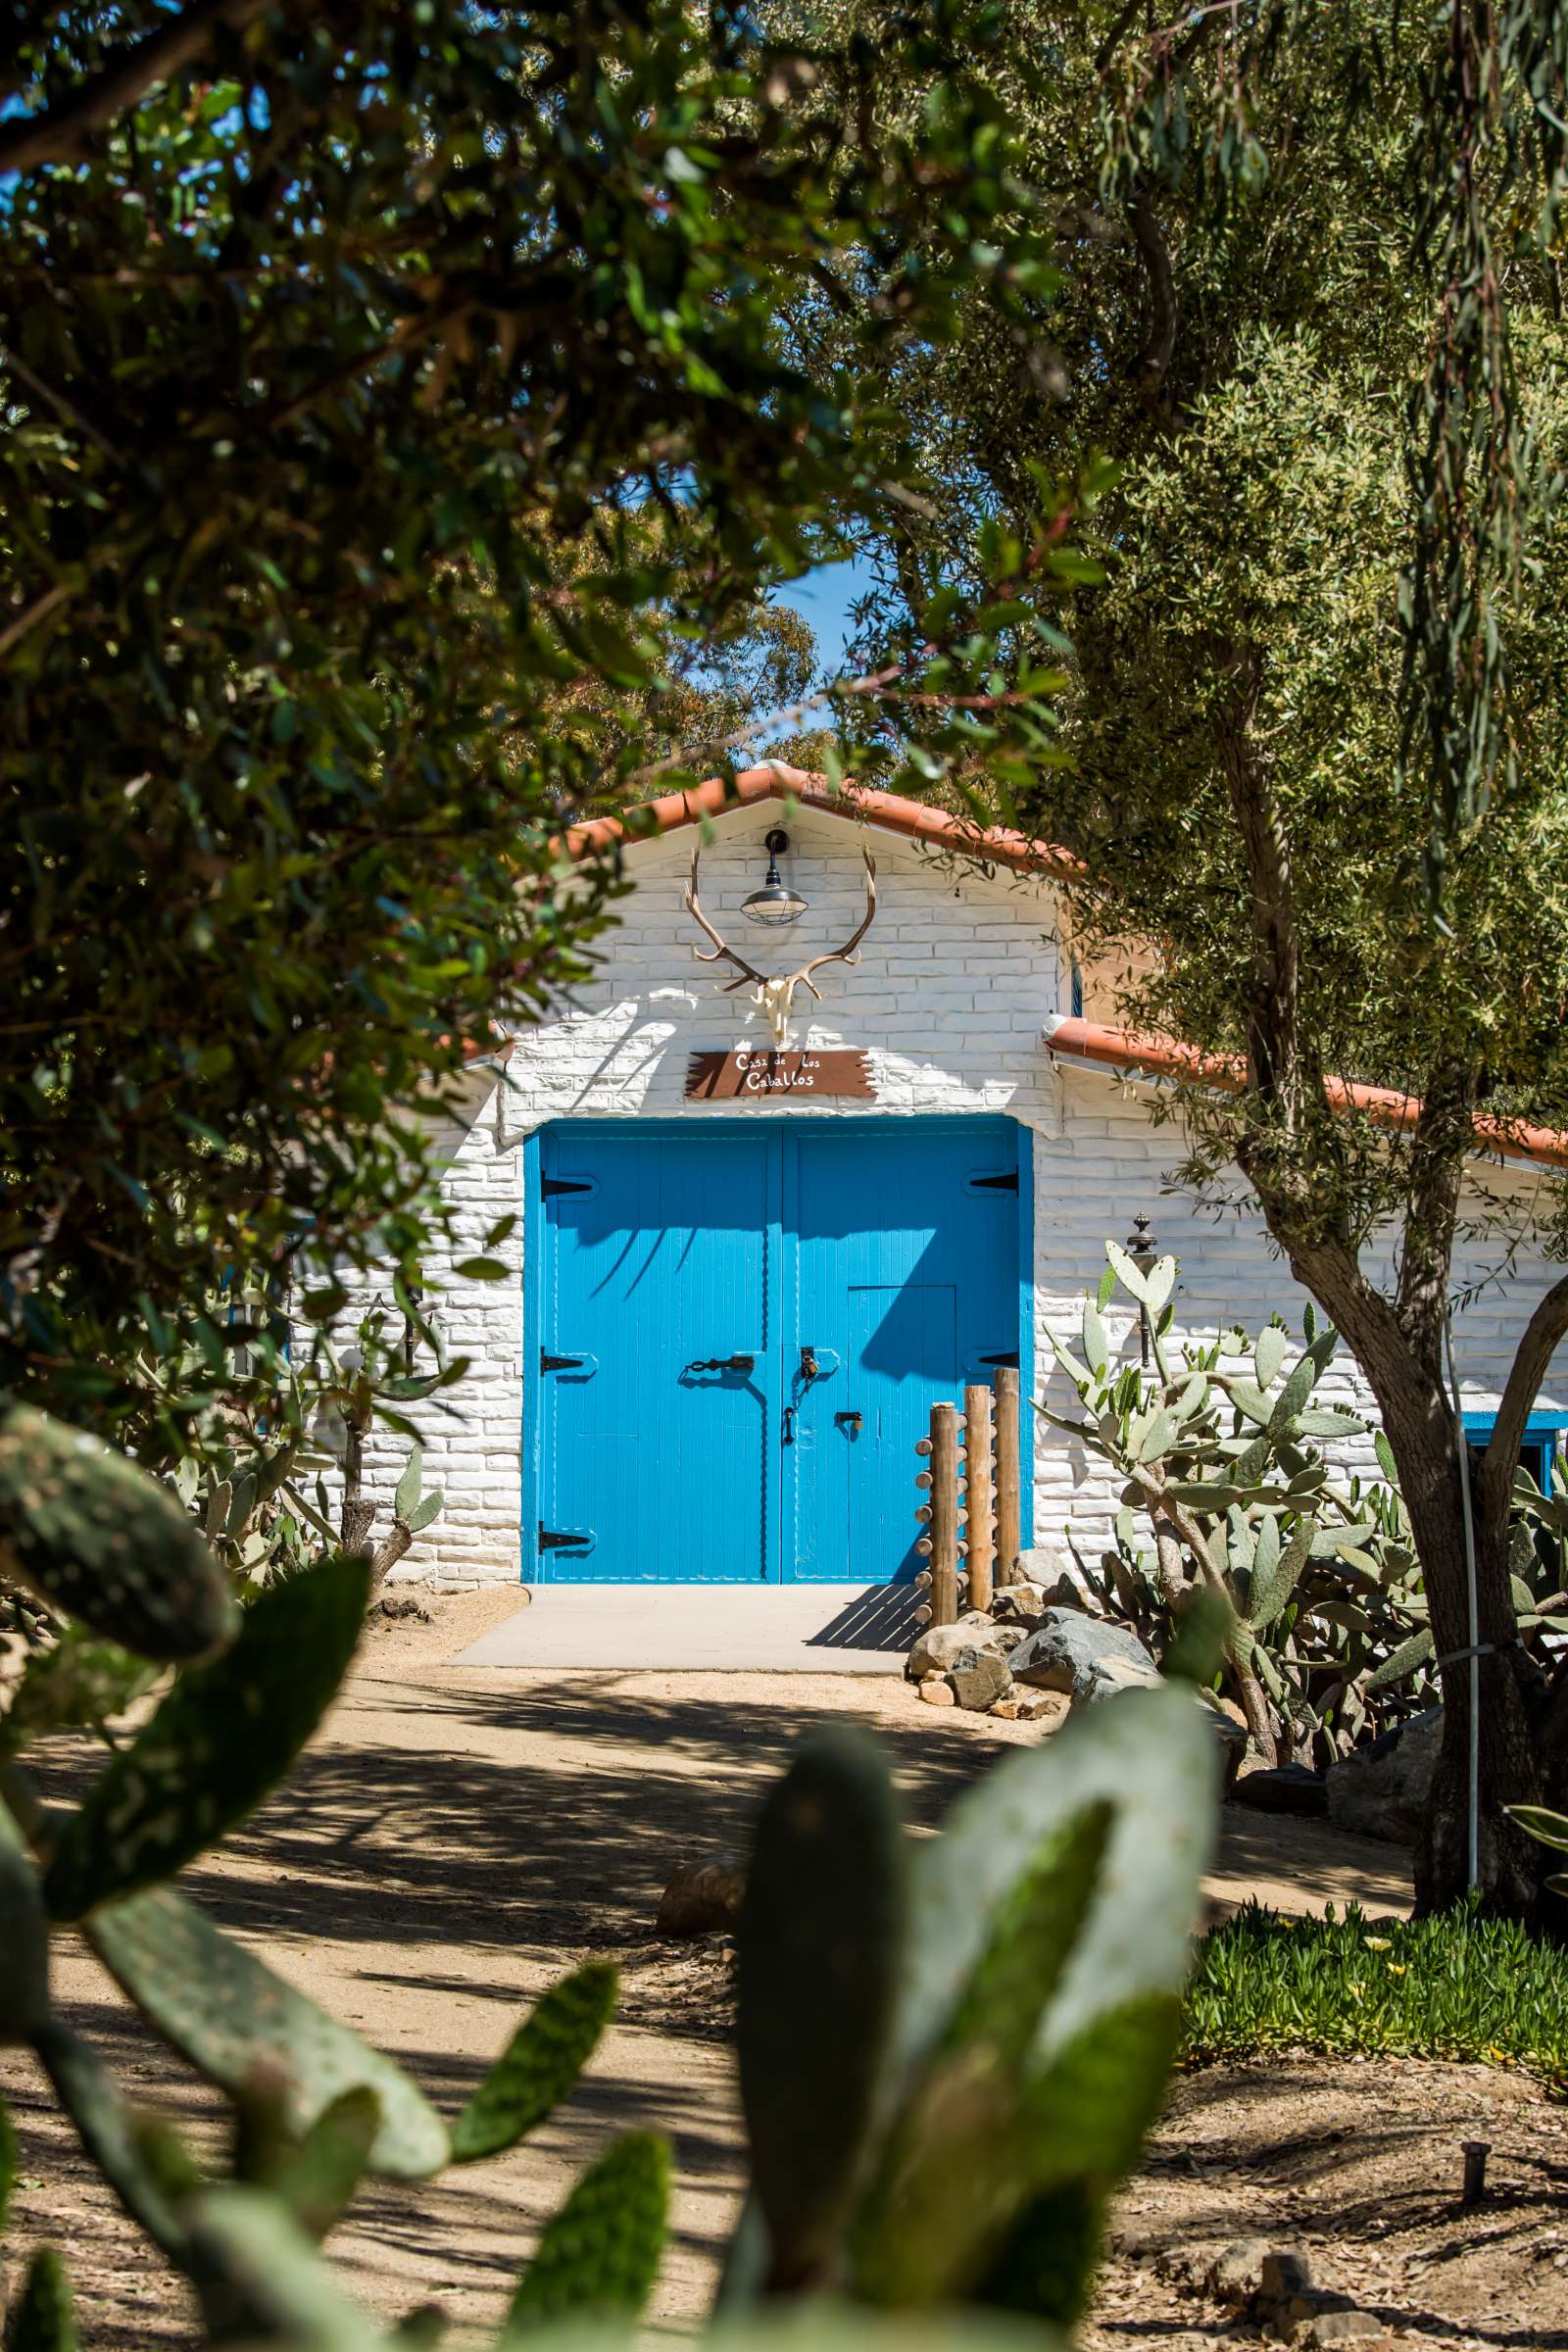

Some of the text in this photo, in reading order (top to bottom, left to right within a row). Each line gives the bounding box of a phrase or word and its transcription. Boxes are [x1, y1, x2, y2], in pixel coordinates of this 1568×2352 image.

[736, 1054, 768, 1070] Casa
[774, 1054, 786, 1065] de
[747, 1071, 814, 1090] Caballos
